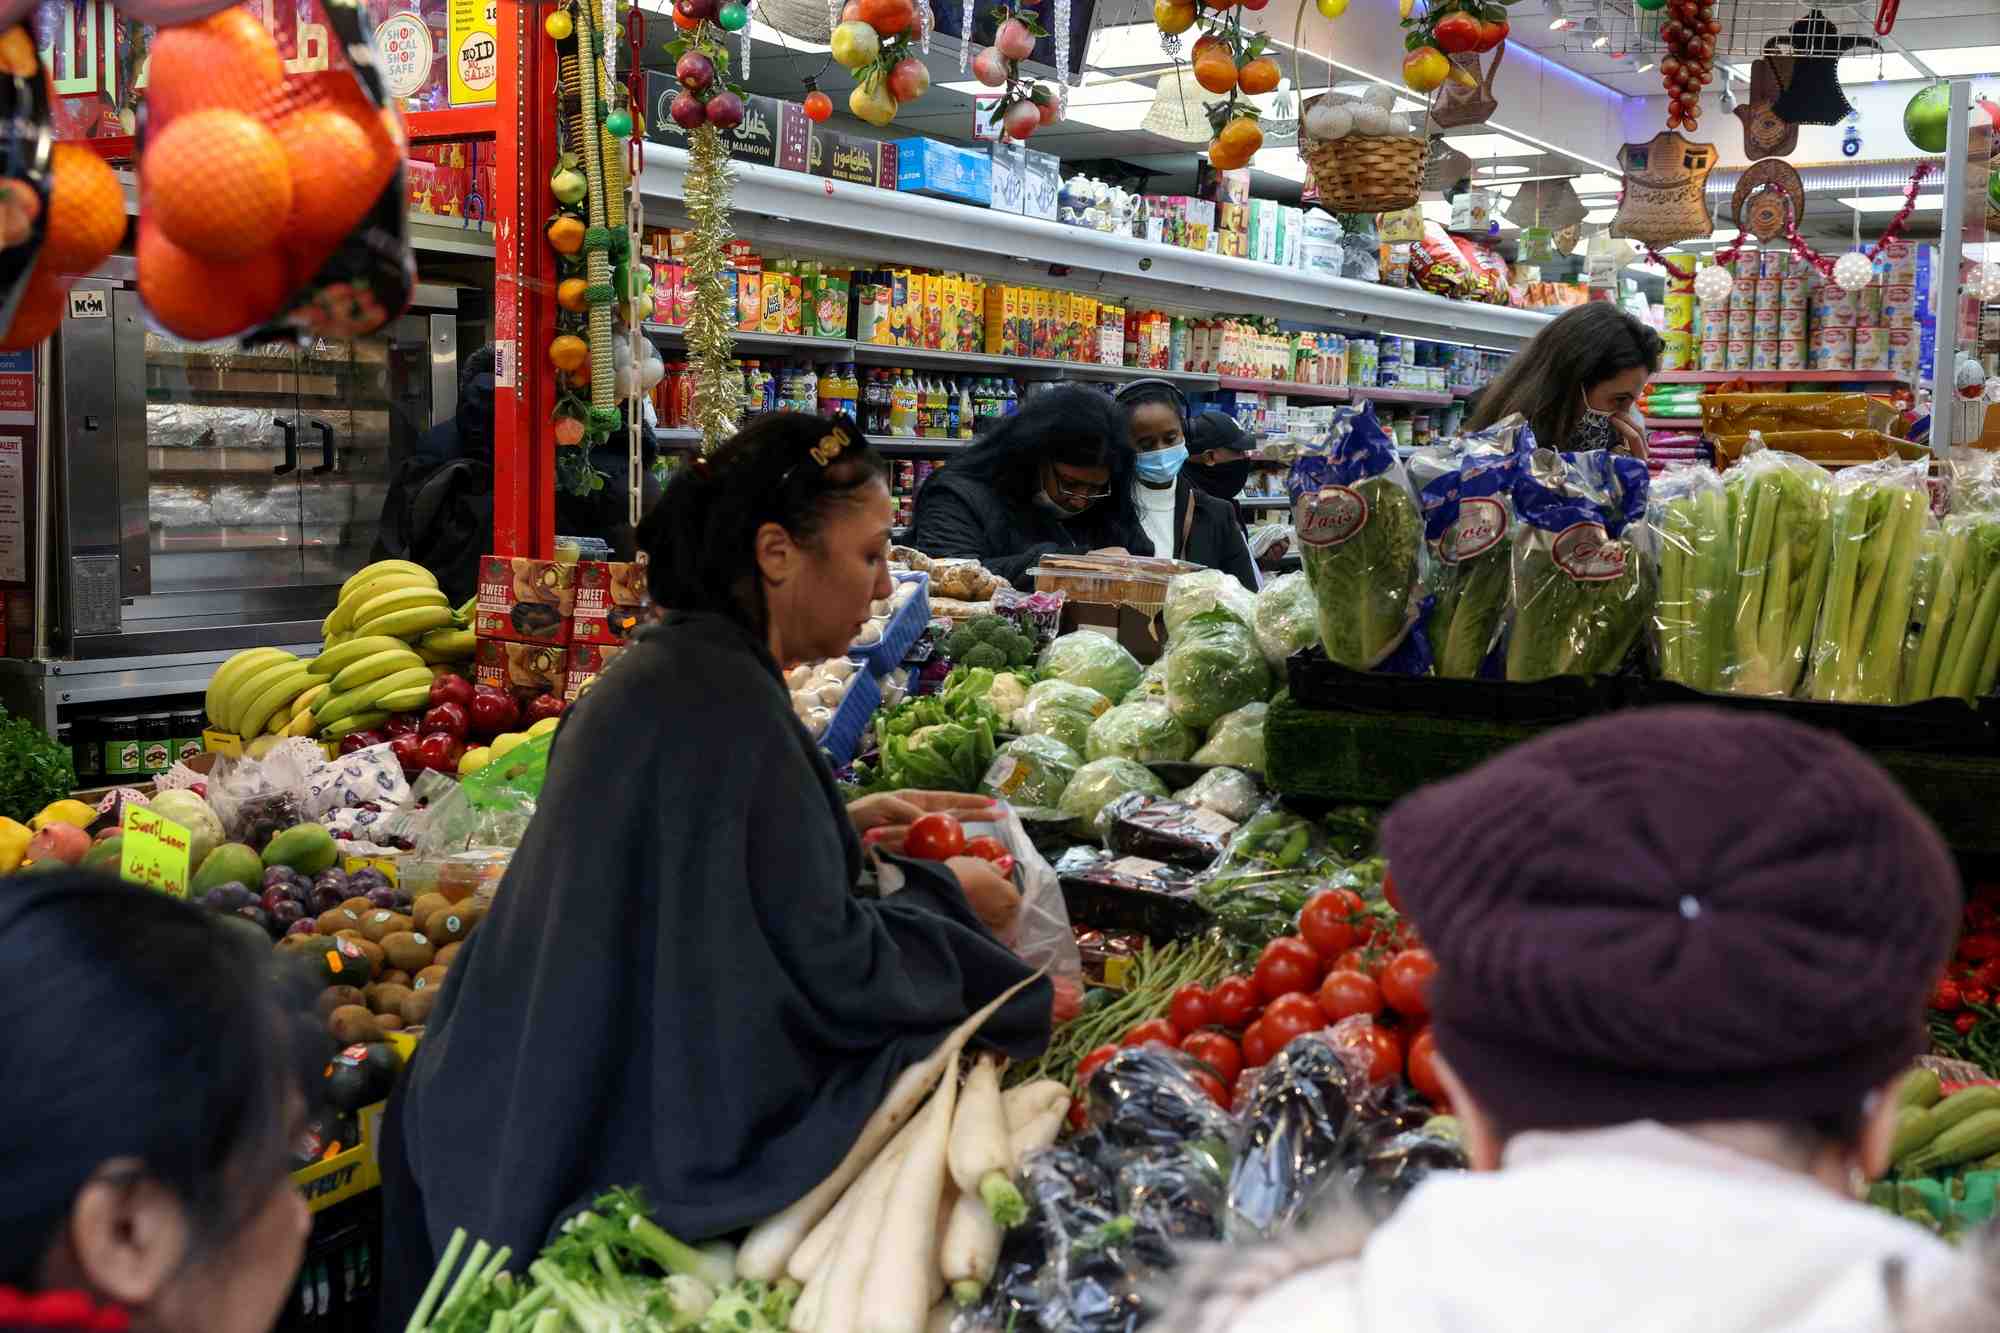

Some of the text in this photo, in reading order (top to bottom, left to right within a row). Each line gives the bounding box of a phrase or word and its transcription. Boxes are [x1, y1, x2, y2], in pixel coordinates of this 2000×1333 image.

[386, 27, 416, 41] SHOP
[384, 40, 417, 53] LOCAL
[475, 40, 494, 61] ID
[386, 51, 416, 64] SHOP
[389, 63, 415, 76] SAFE
[464, 64, 495, 82] SALE!
[75, 299, 103, 312] MCM
[480, 583, 508, 597] SWEET
[577, 588, 605, 601] SWEET
